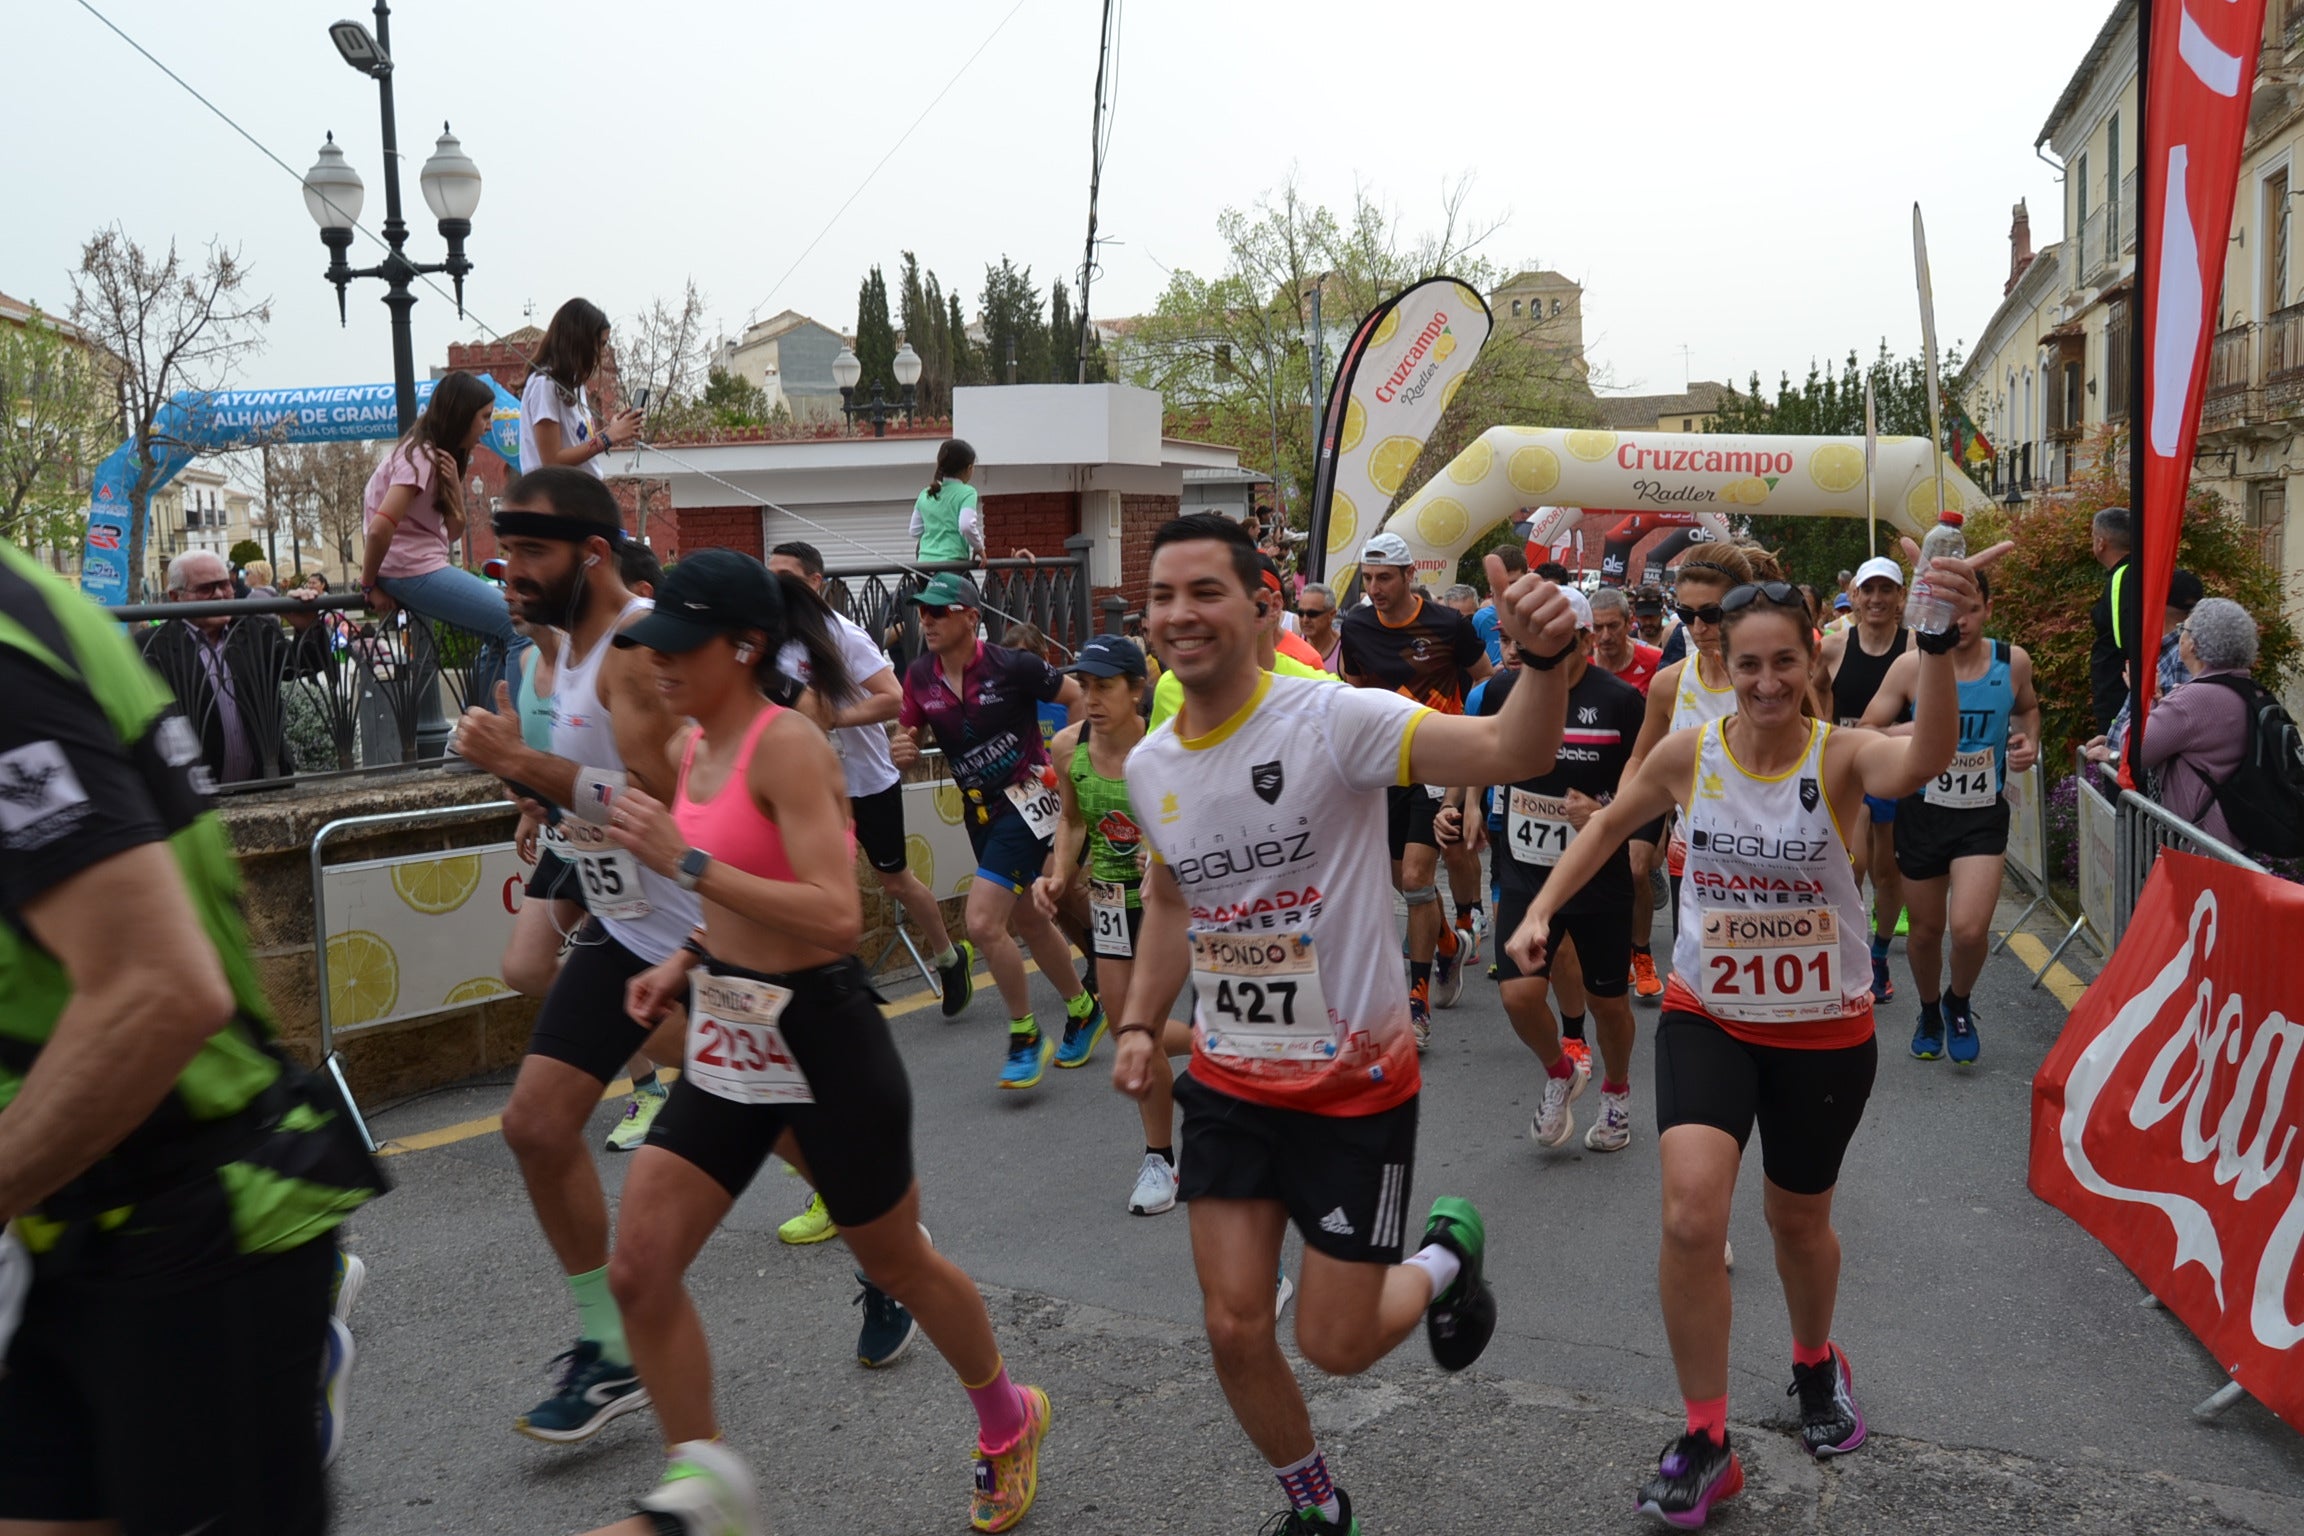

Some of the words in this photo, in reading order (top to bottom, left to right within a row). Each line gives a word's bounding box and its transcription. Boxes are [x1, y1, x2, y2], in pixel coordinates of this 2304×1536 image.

[1375, 311, 1448, 404] Cruzcampo
[212, 384, 395, 407] AYUNTAMIENTO
[1400, 361, 1440, 406] Radler
[301, 407, 329, 424] DE
[331, 404, 429, 423] GRANAA
[319, 425, 336, 437] DE
[1617, 441, 1794, 478] Cruzcampo
[1633, 477, 1717, 504] Radler
[1951, 756, 1985, 768] ONDO
[1938, 771, 1988, 795] 914
[1517, 820, 1568, 852] 471
[1730, 918, 1813, 939] FONDO
[1211, 942, 1287, 966] FONDO
[1709, 951, 1831, 996] 2101
[1215, 978, 1298, 1026] 427
